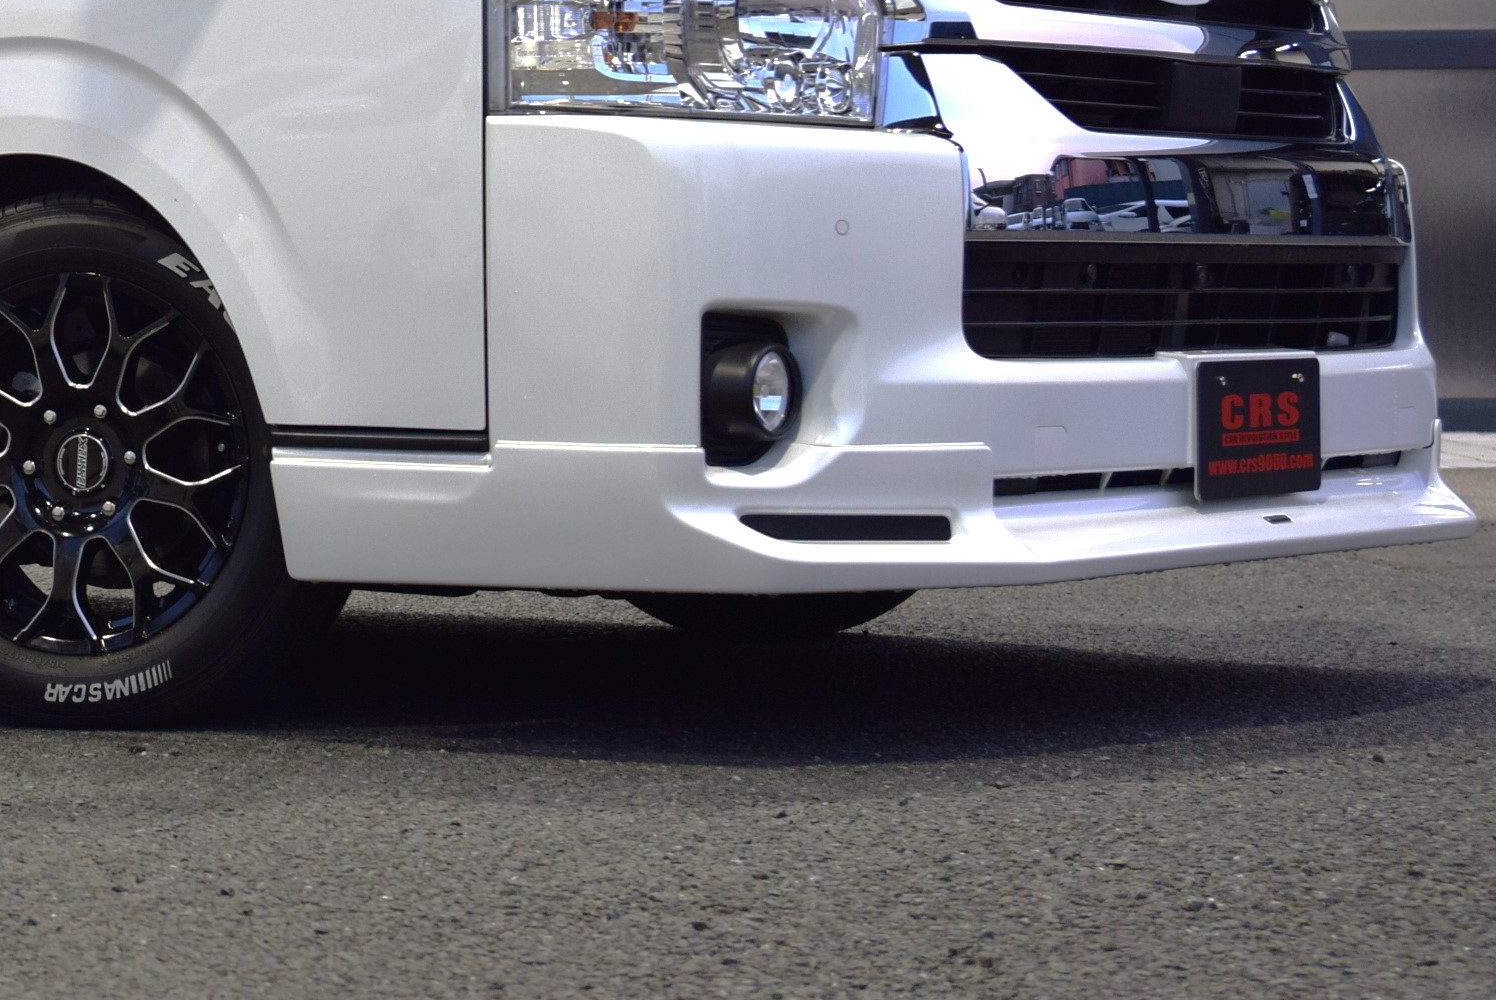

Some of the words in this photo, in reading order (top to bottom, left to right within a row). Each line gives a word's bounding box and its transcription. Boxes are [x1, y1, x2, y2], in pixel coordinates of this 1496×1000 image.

[1221, 391, 1300, 430] CRS
[1208, 453, 1313, 476] www.crs9000.com
[44, 677, 131, 704] NASCAR
